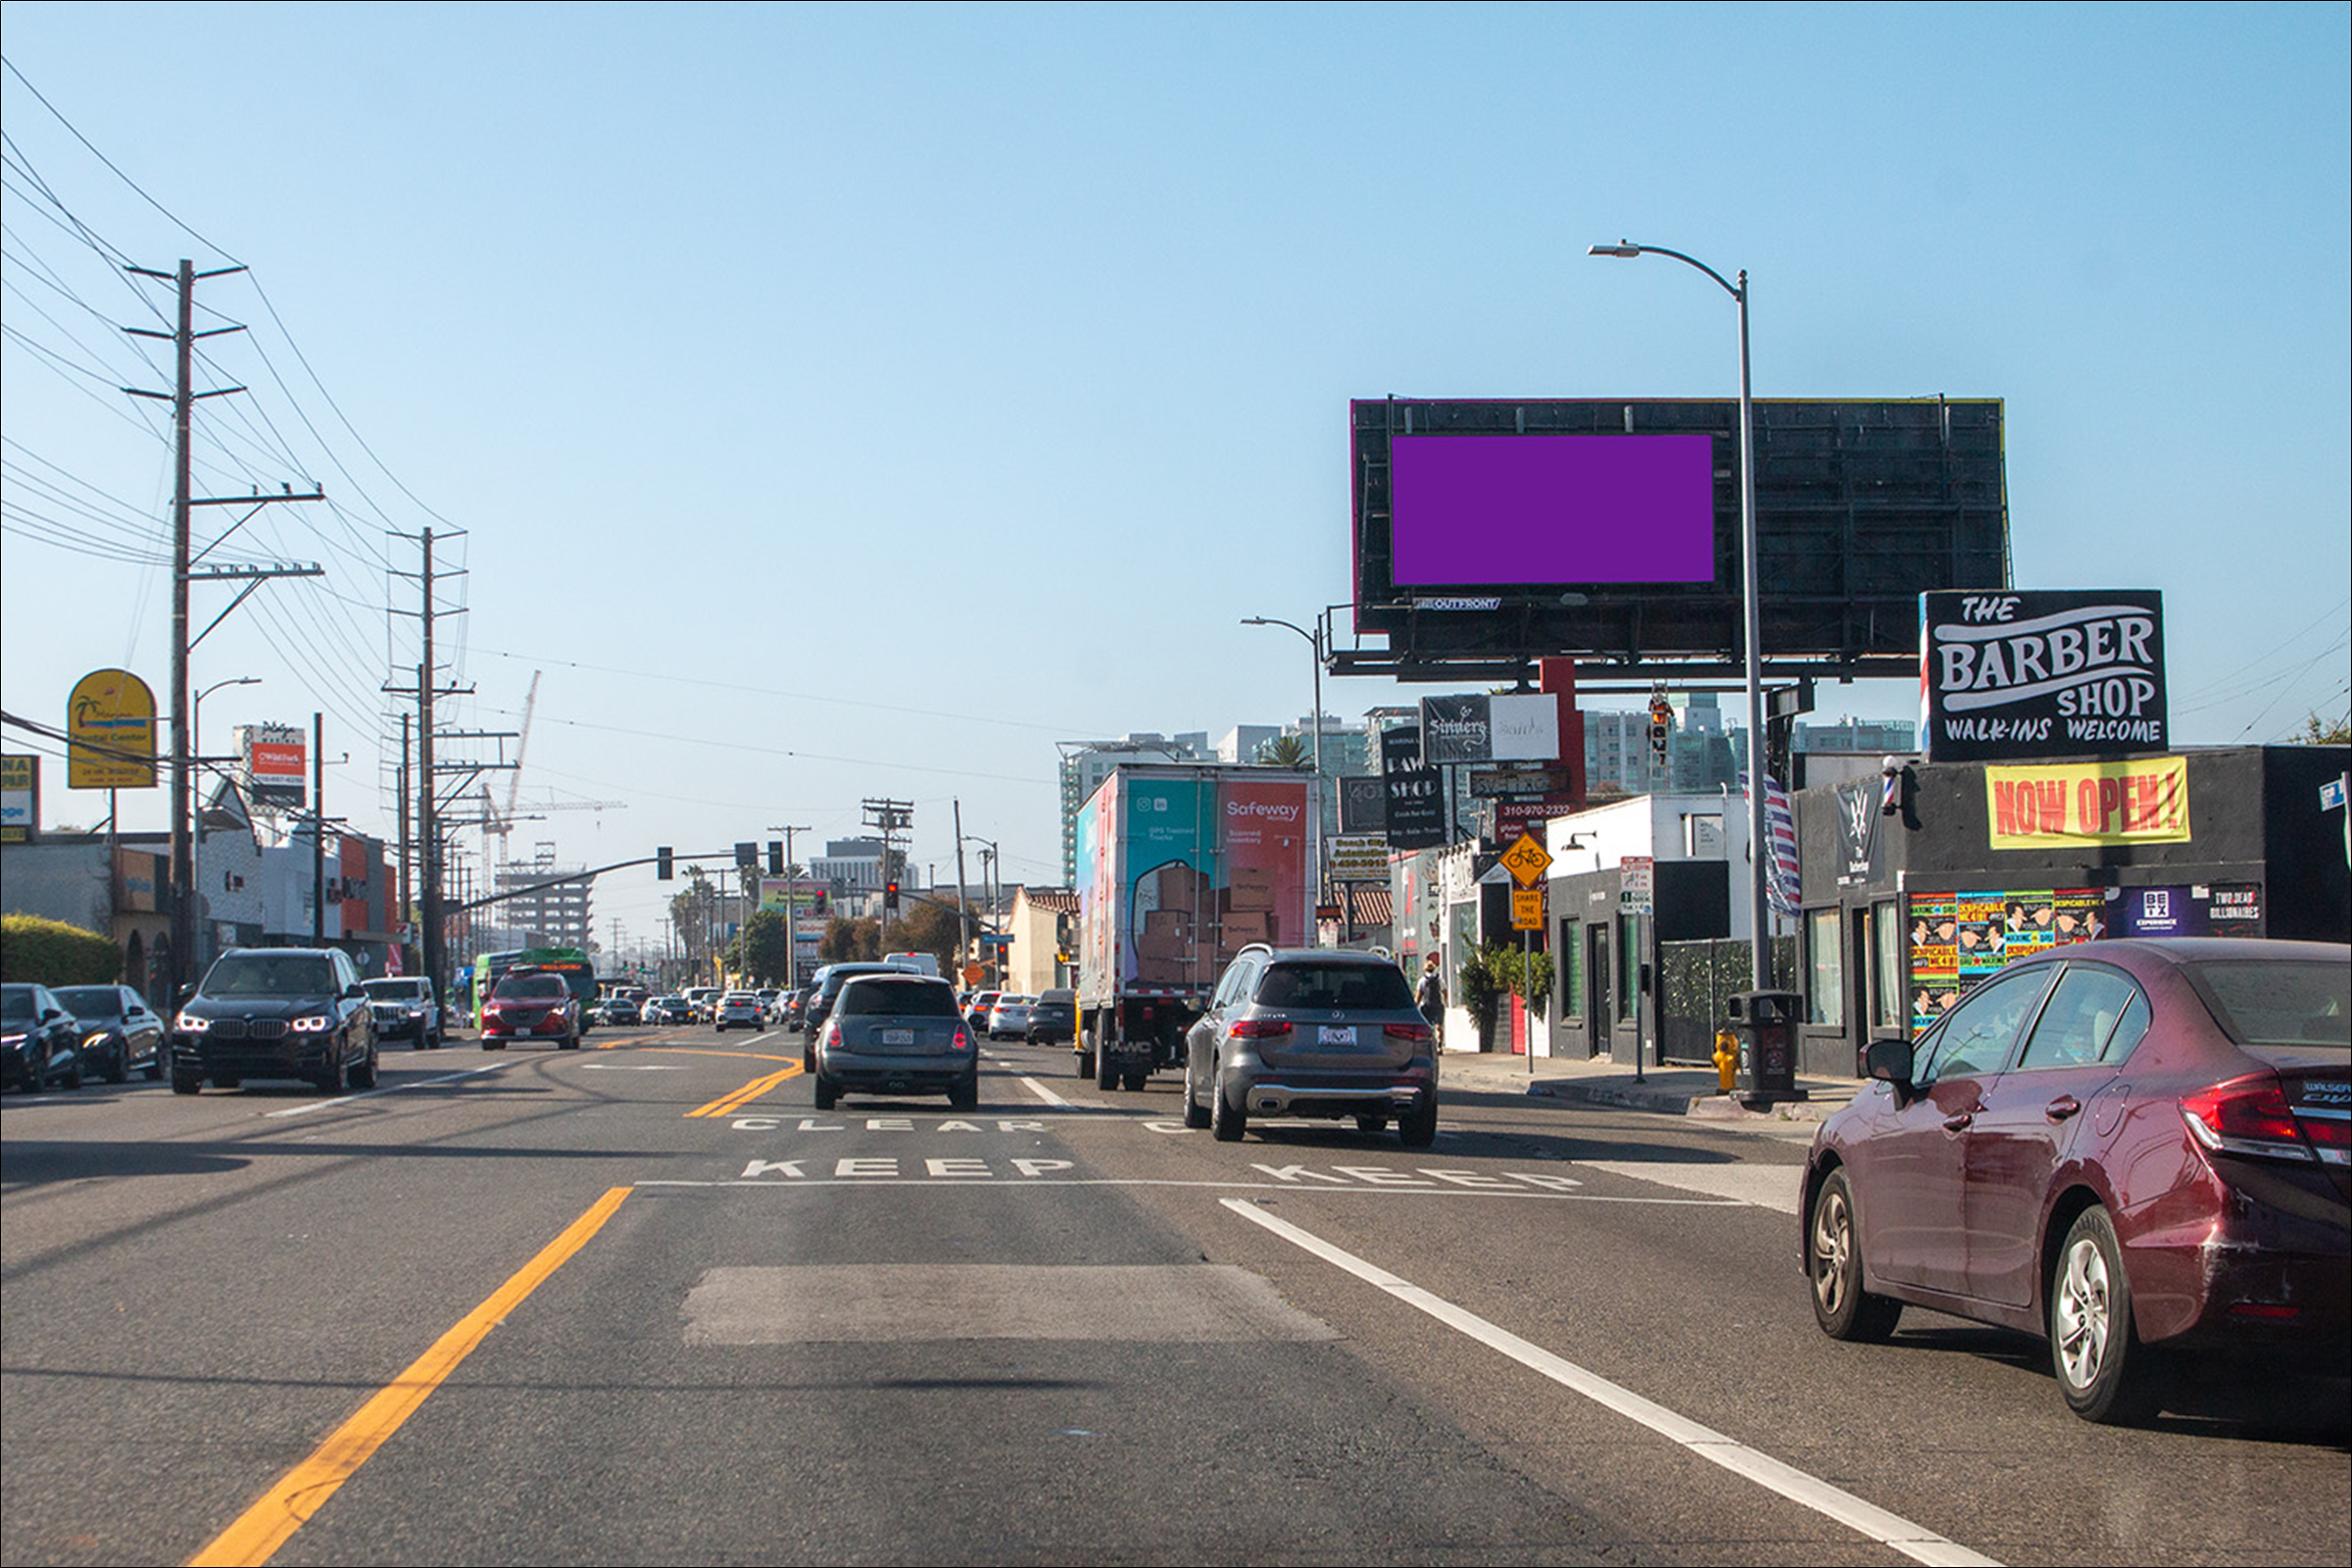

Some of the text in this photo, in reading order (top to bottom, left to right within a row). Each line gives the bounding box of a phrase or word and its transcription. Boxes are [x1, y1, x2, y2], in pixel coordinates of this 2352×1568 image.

[1434, 598, 1500, 610] OUTFRONT
[1962, 596, 2021, 621] THE
[1937, 616, 2154, 692] BARBER
[2057, 677, 2155, 717] SHOP
[1944, 717, 2162, 744] WALK-INS WELCOME
[1391, 780, 1438, 799] SHOP
[1227, 801, 1300, 822] Safeway
[1503, 805, 1570, 816] 310-970-2332
[1993, 779, 2068, 836] NOW
[1515, 893, 1540, 903] SHARE
[1520, 905, 1535, 914] THE
[731, 1117, 1052, 1133] CLEAR
[740, 1157, 1075, 1178] KEEP
[1250, 1162, 1584, 1192] KEEP
